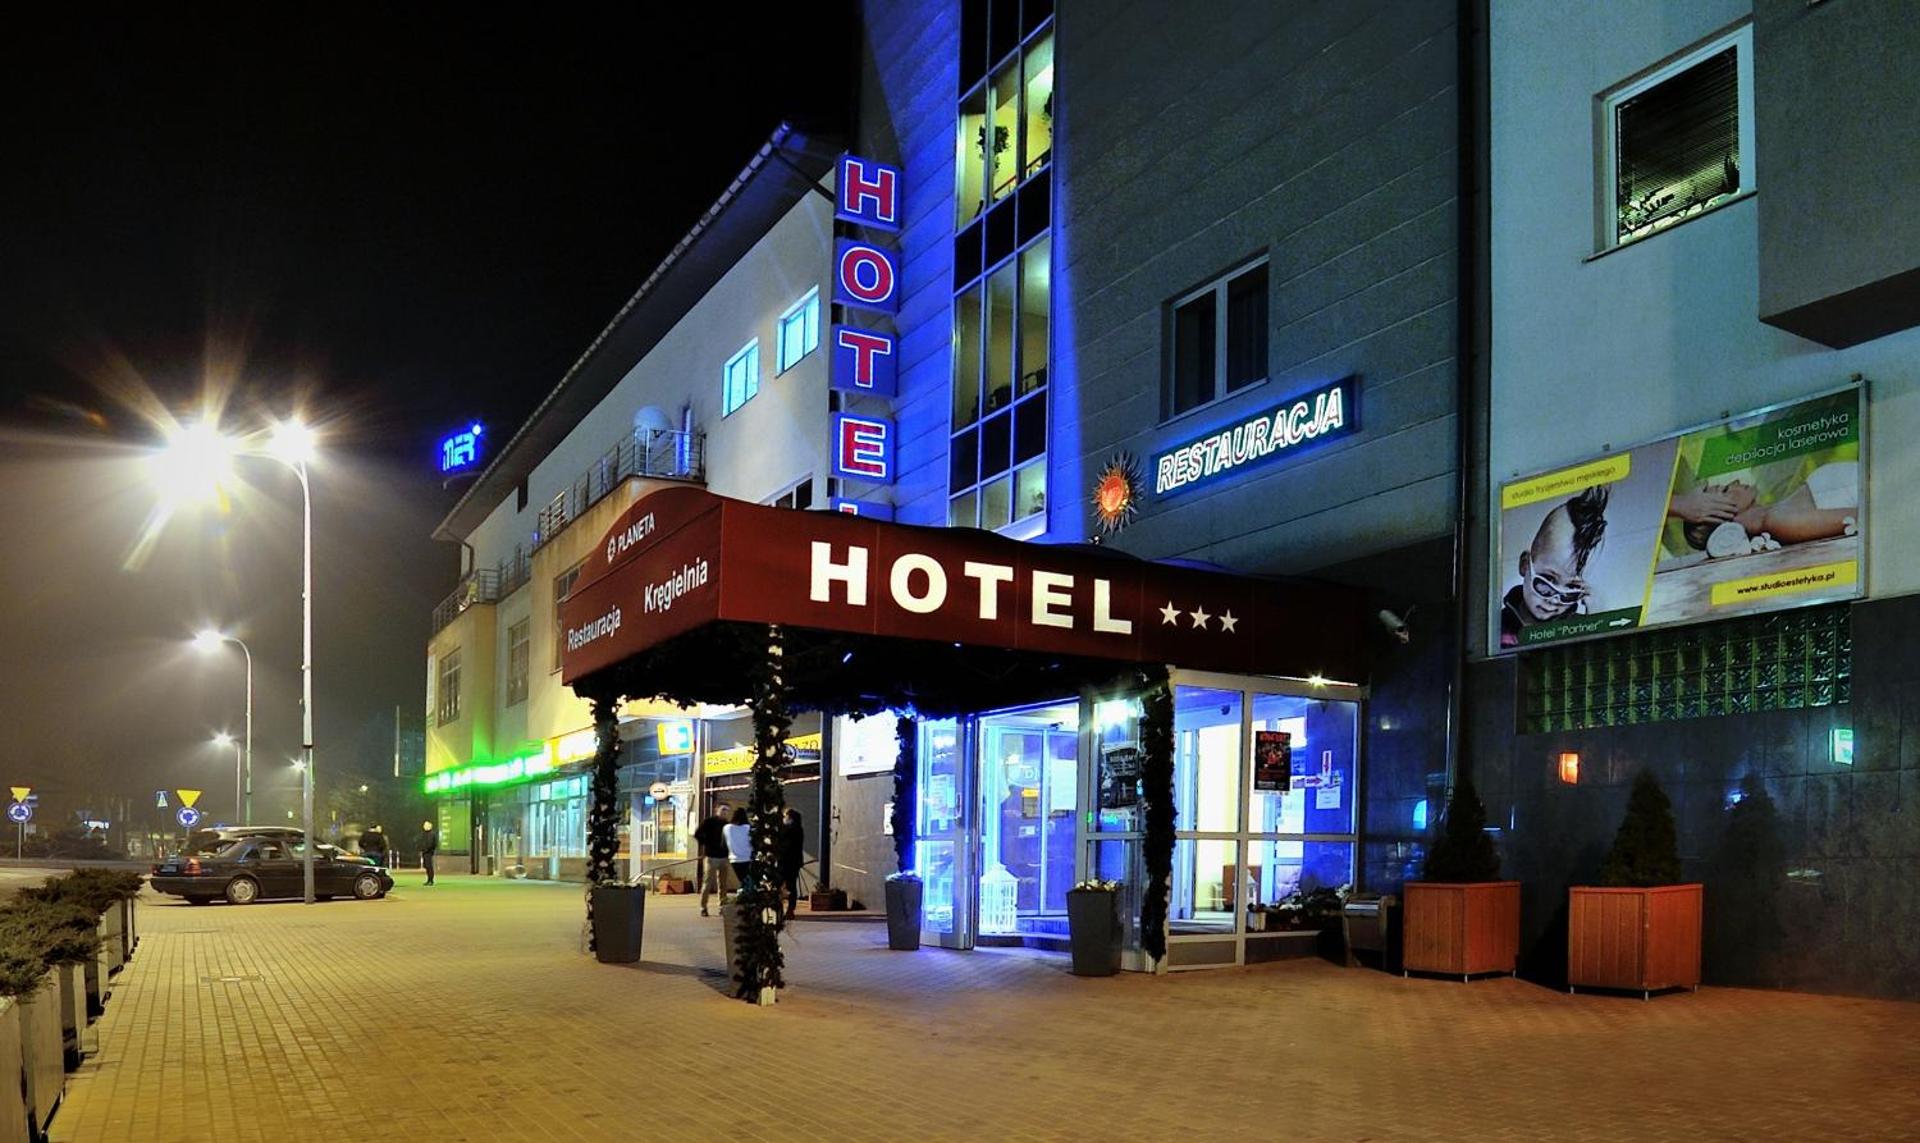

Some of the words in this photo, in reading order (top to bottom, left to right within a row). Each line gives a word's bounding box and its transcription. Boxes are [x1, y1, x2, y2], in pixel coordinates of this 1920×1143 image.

[840, 159, 894, 513] HOTE
[1156, 387, 1344, 494] RESTAURACJA
[1725, 441, 1786, 466] depilacja
[1788, 426, 1849, 450] laserowa
[1778, 411, 1849, 440] kosmetyka
[617, 512, 656, 554] PLANETA
[644, 556, 708, 614] Kręgielnia
[810, 541, 1133, 635] HOTEL
[1736, 570, 1836, 595] www.studioestetyka.pl
[567, 604, 622, 653] Restauracja
[1529, 627, 1556, 641] Hotel
